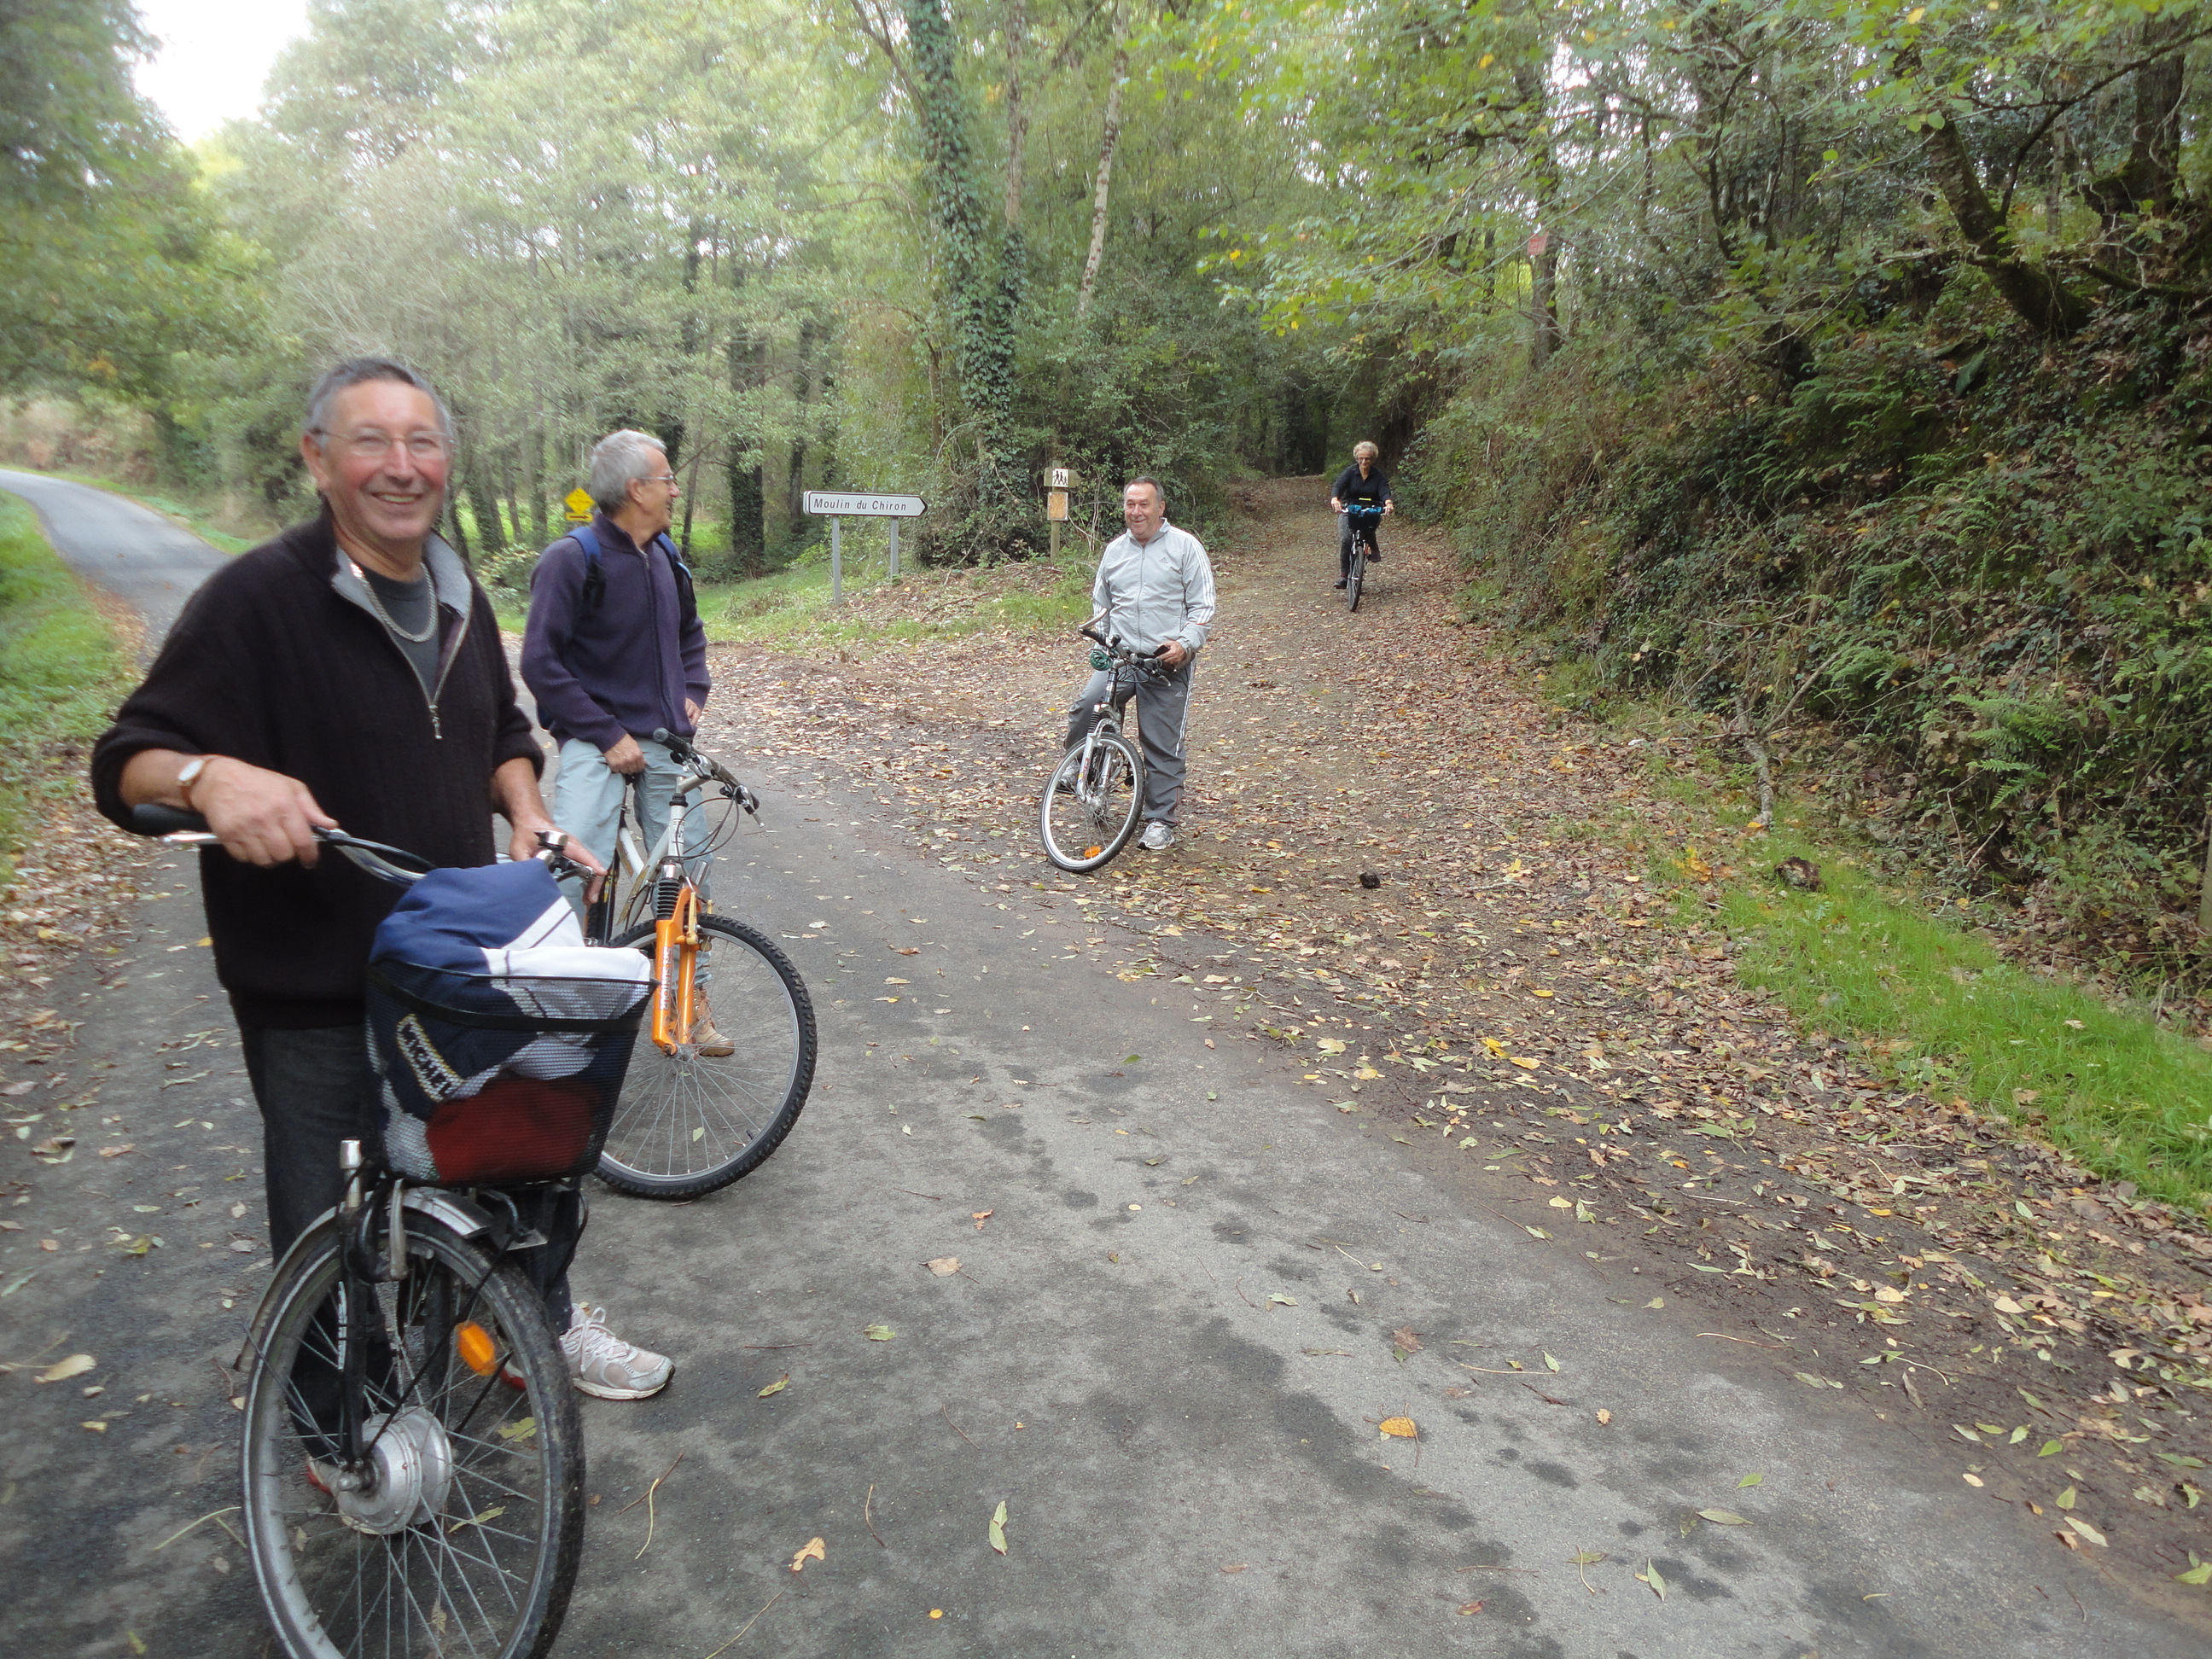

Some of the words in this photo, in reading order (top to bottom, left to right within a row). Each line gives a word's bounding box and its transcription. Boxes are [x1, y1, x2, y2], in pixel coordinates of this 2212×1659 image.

[813, 498, 850, 509] Moulin
[856, 499, 867, 509] du
[872, 500, 906, 511] Chiron
